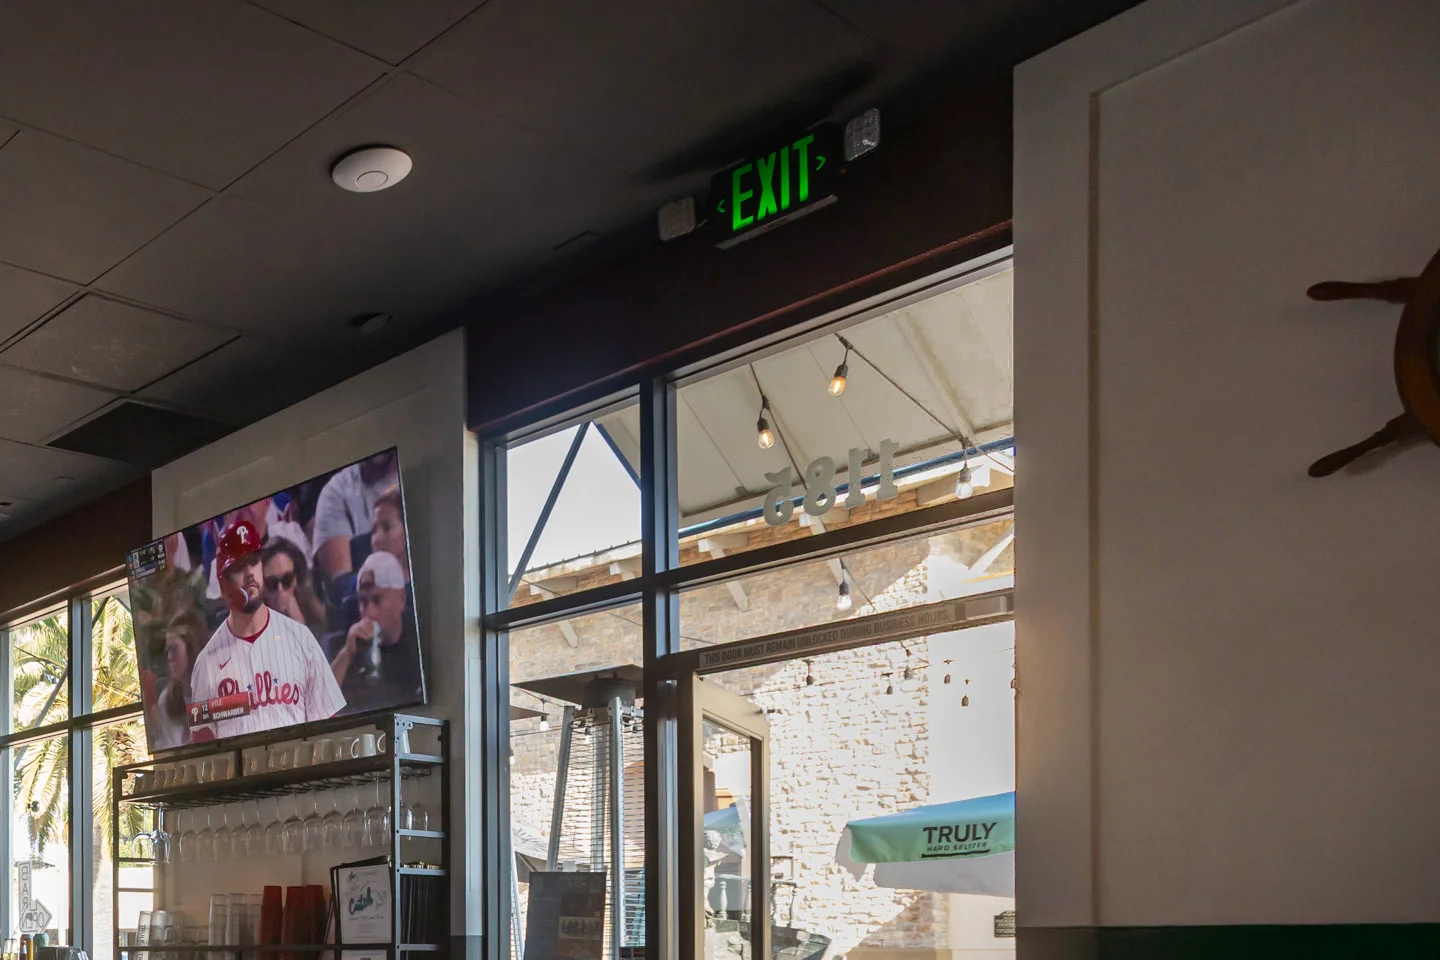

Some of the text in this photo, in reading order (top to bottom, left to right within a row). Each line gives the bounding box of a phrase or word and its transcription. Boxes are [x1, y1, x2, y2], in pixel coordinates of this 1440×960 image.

[732, 133, 814, 231] EXIT
[704, 608, 949, 665] THIS DOOR MUST REMAIN UNLOCKED DURING BUSINESS HOURS
[922, 822, 998, 844] TRULY
[927, 841, 988, 852] HARD SELTZER
